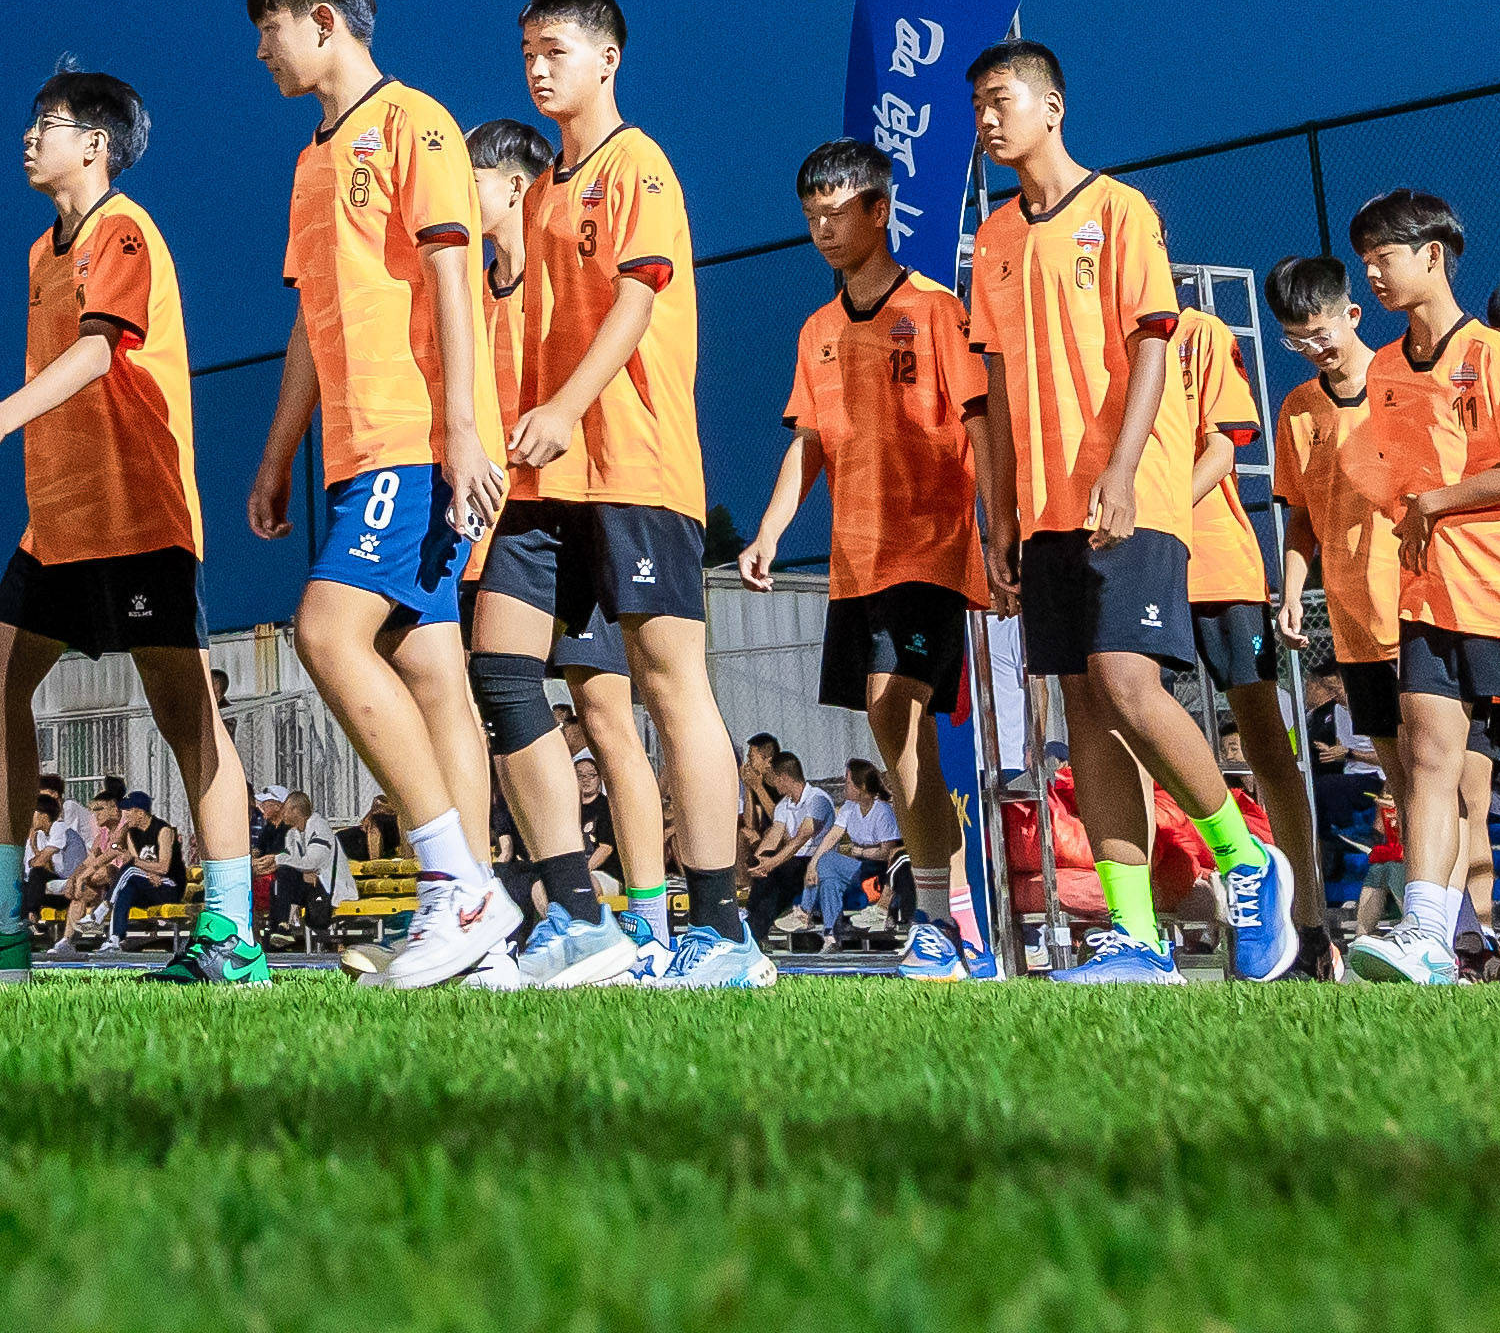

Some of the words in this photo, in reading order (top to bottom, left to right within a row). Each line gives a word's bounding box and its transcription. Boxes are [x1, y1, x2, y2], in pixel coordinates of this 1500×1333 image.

[350, 167, 371, 209] 8
[577, 219, 598, 258] 3
[1074, 255, 1095, 291] 6
[888, 348, 918, 386] 12
[1452, 396, 1479, 432] 11
[361, 470, 400, 532] 8
[348, 547, 381, 563] KELME
